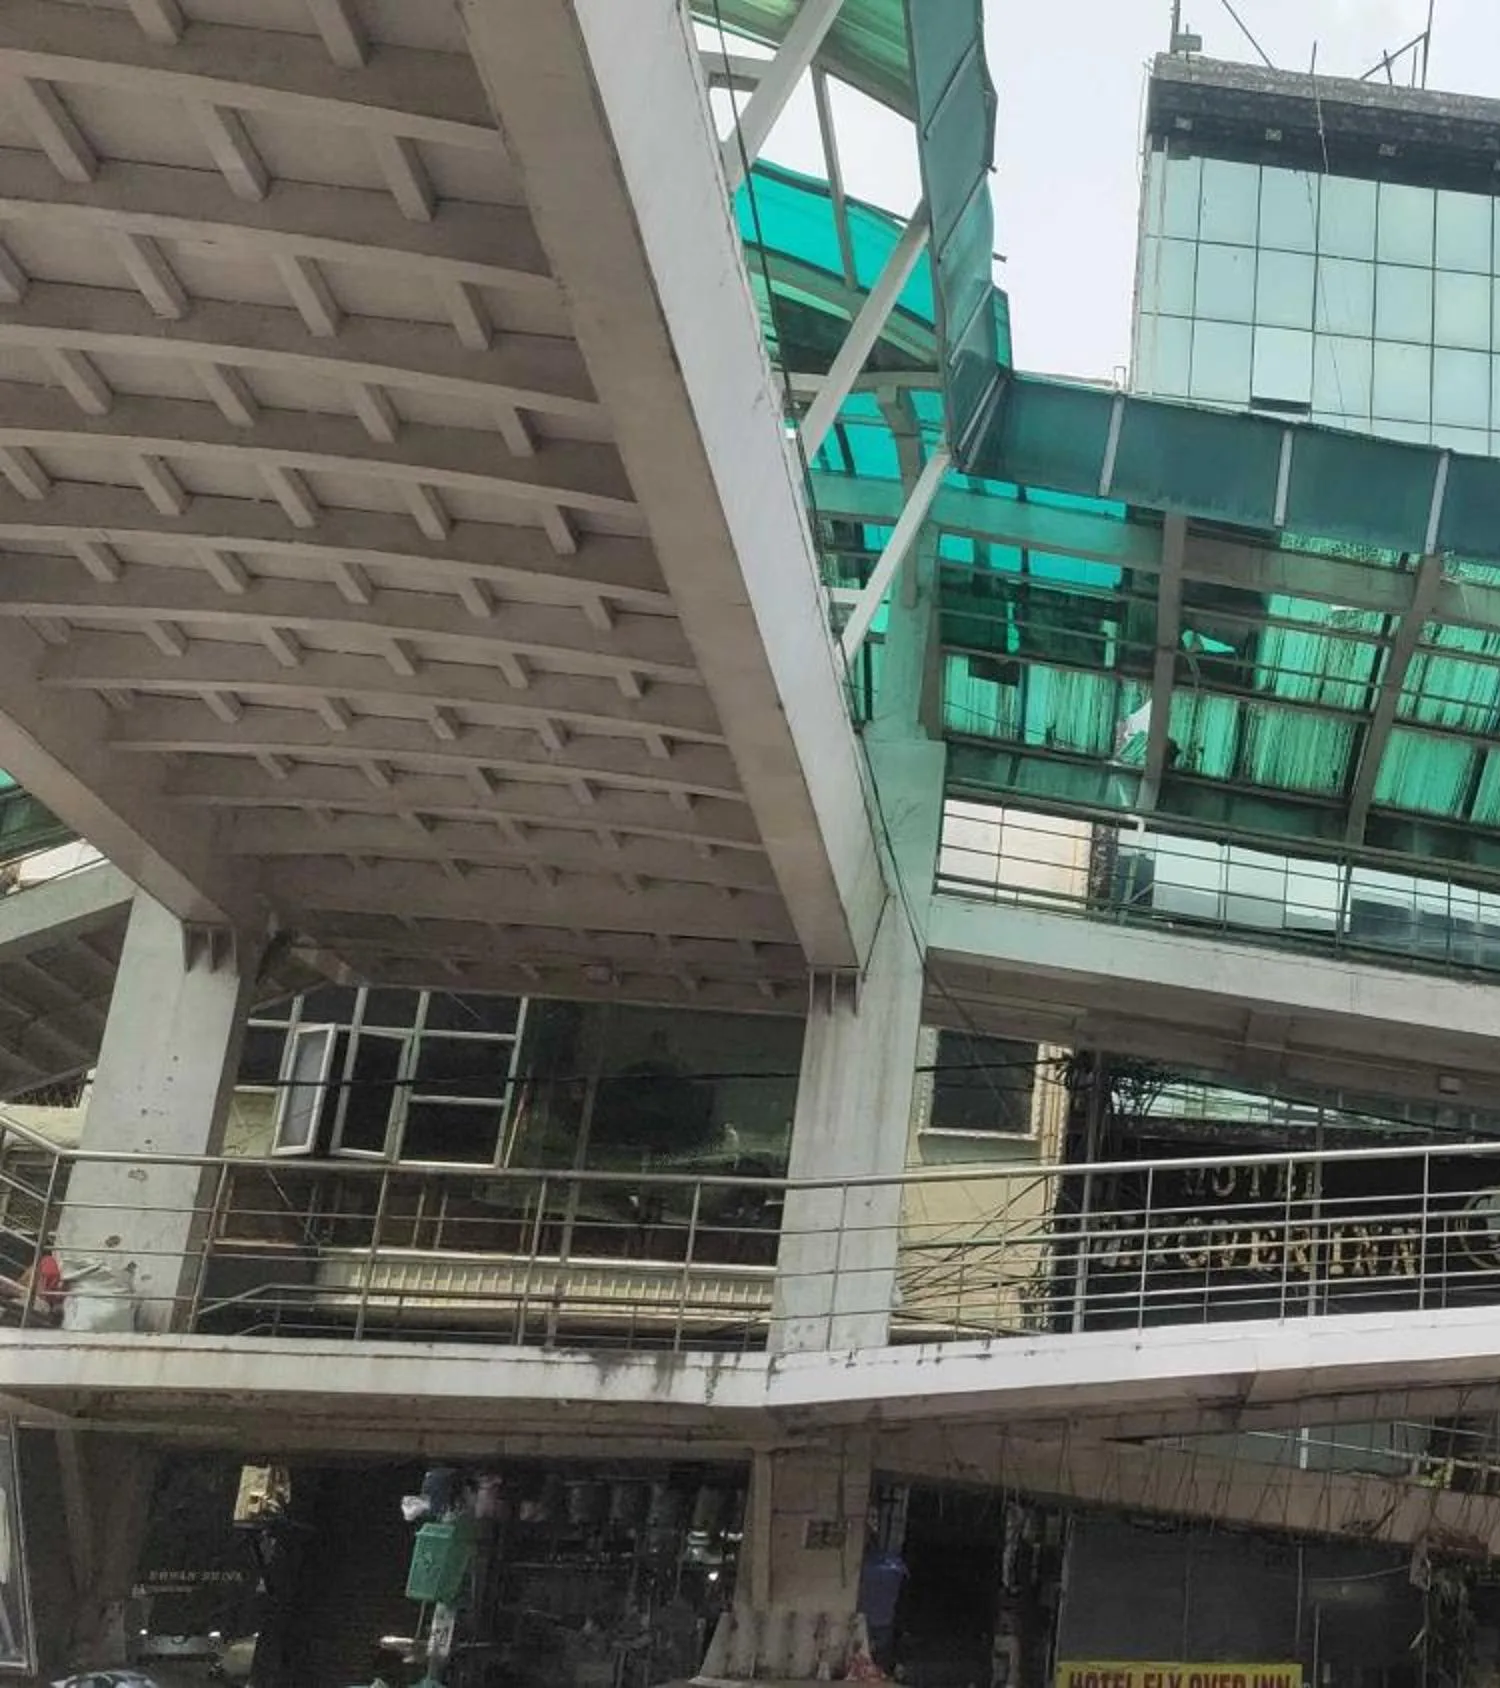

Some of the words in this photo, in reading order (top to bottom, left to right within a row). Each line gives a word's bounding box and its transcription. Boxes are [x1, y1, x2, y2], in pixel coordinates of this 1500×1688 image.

[1070, 1670, 1132, 1688] HOTEL
[1143, 1671, 1181, 1688] FLY
[1190, 1671, 1245, 1688] OVER
[1254, 1672, 1291, 1688] INN
